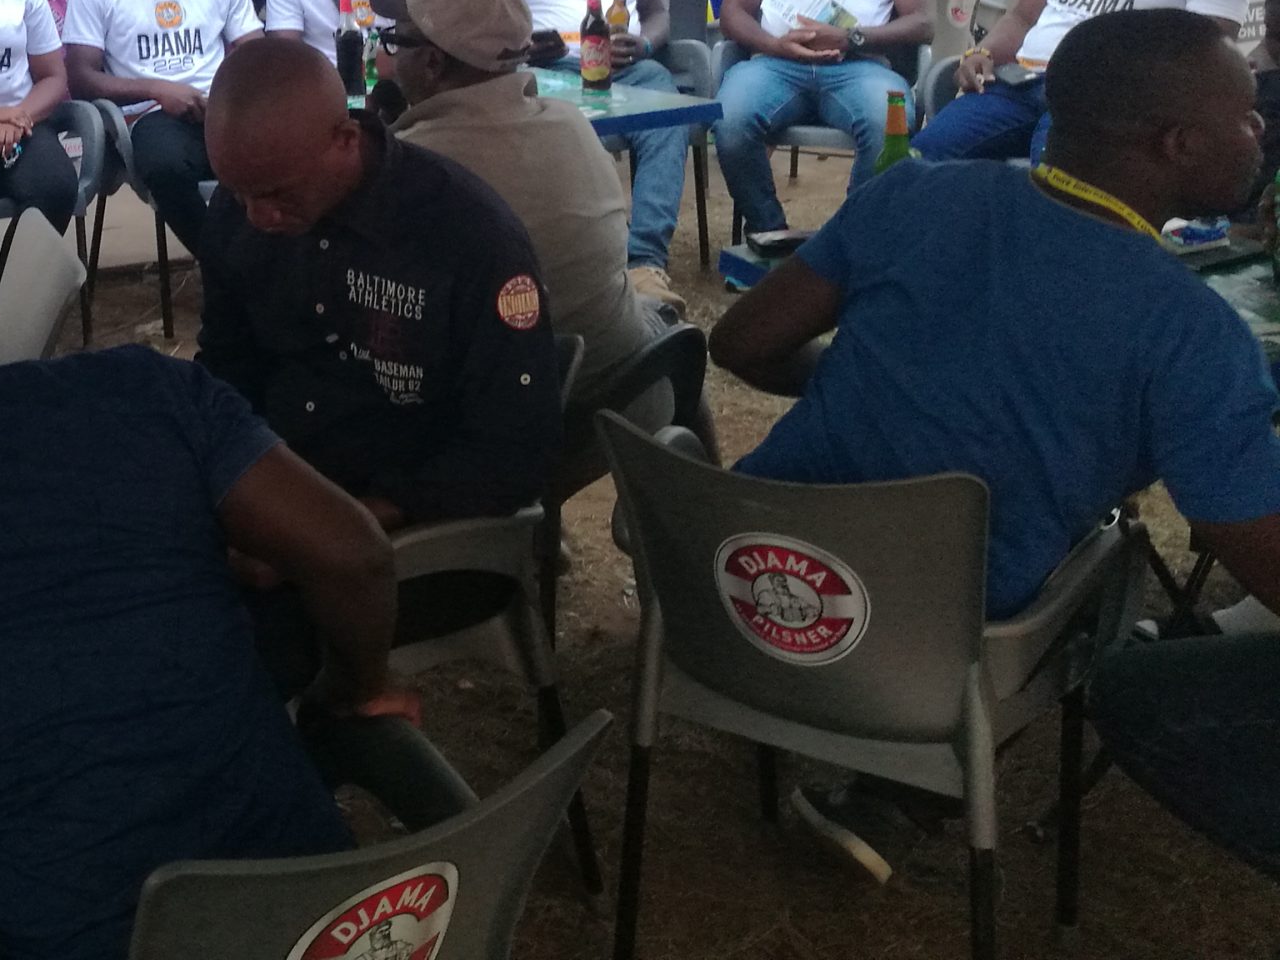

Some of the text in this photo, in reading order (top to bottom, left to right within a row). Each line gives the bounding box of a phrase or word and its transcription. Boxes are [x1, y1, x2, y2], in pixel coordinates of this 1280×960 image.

[136, 27, 204, 60] DJAMA
[346, 268, 426, 307] BALTIMORE
[348, 286, 423, 321] ATHLETICS
[374, 359, 424, 379] BASEMAN
[738, 550, 827, 588] DJAMA
[752, 616, 833, 645] PILSNER
[330, 882, 438, 944] DJAMA
